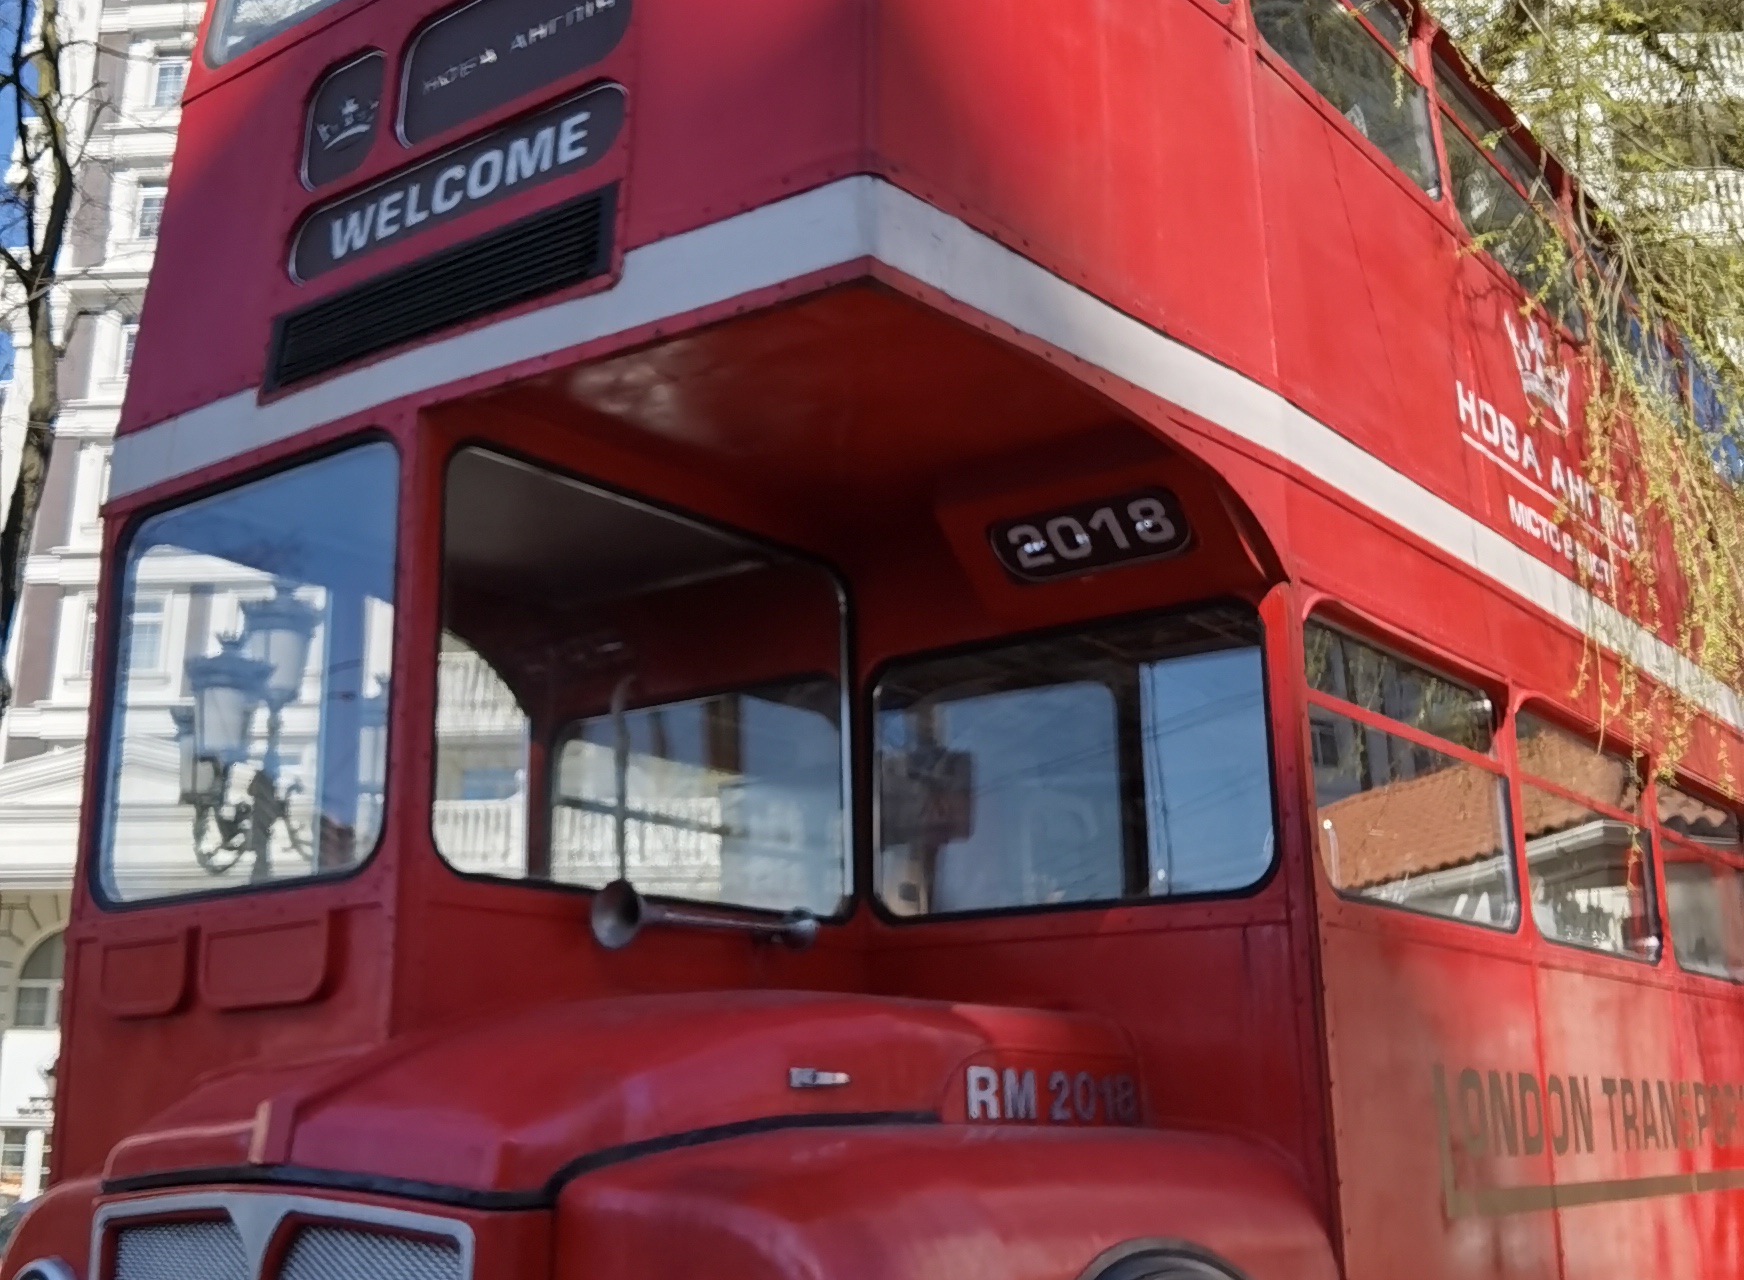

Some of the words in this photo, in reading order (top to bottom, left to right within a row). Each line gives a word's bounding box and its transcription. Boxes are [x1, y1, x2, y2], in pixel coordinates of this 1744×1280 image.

[329, 111, 591, 260] WELCOME
[1455, 380, 1543, 481] НОВА
[1006, 497, 1176, 569] 2018
[1508, 494, 1561, 553] МІСТО
[966, 1065, 1037, 1120] RM
[1048, 1070, 1138, 1121] 2018
[1432, 1062, 1594, 1218] LONDON
[1601, 1076, 1744, 1153] TRANSPOR
